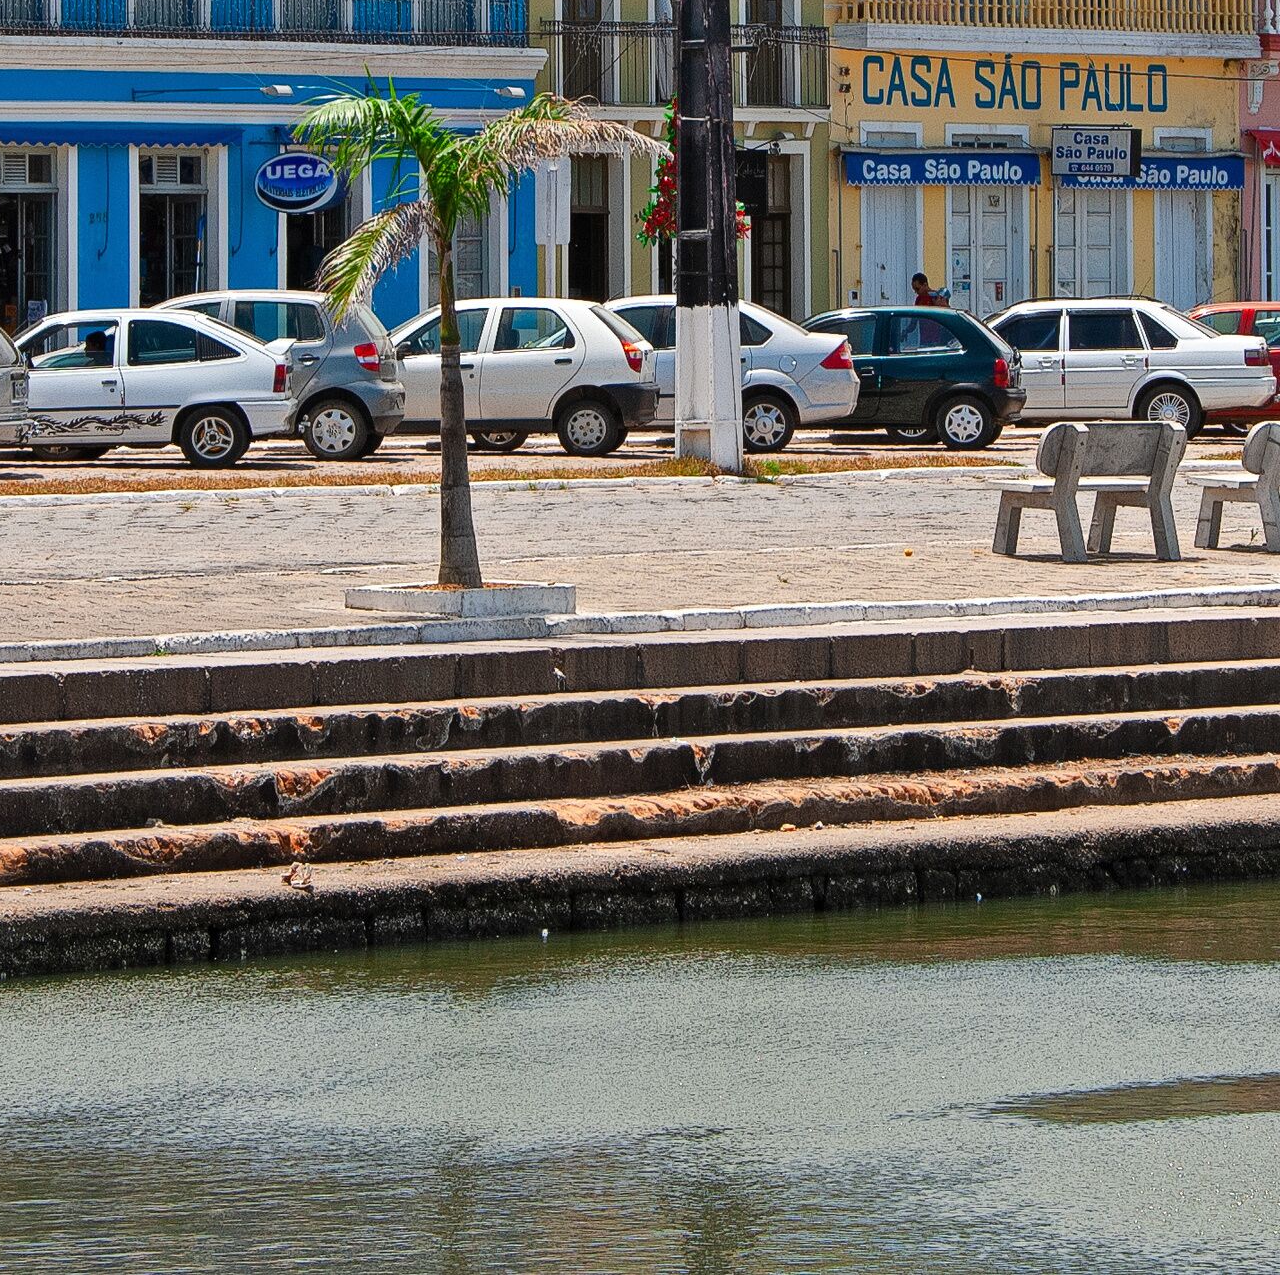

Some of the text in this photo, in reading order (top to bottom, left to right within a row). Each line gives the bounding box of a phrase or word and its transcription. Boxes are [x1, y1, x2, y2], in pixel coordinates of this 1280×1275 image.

[862, 53, 1168, 112] CASA SÃO PAULO
[1073, 131, 1109, 145] Casa
[1055, 146, 1128, 160] São Paulo
[265, 164, 331, 180] UEGA
[862, 158, 1022, 180] Casa São Paulo
[1176, 165, 1229, 185] Paulo
